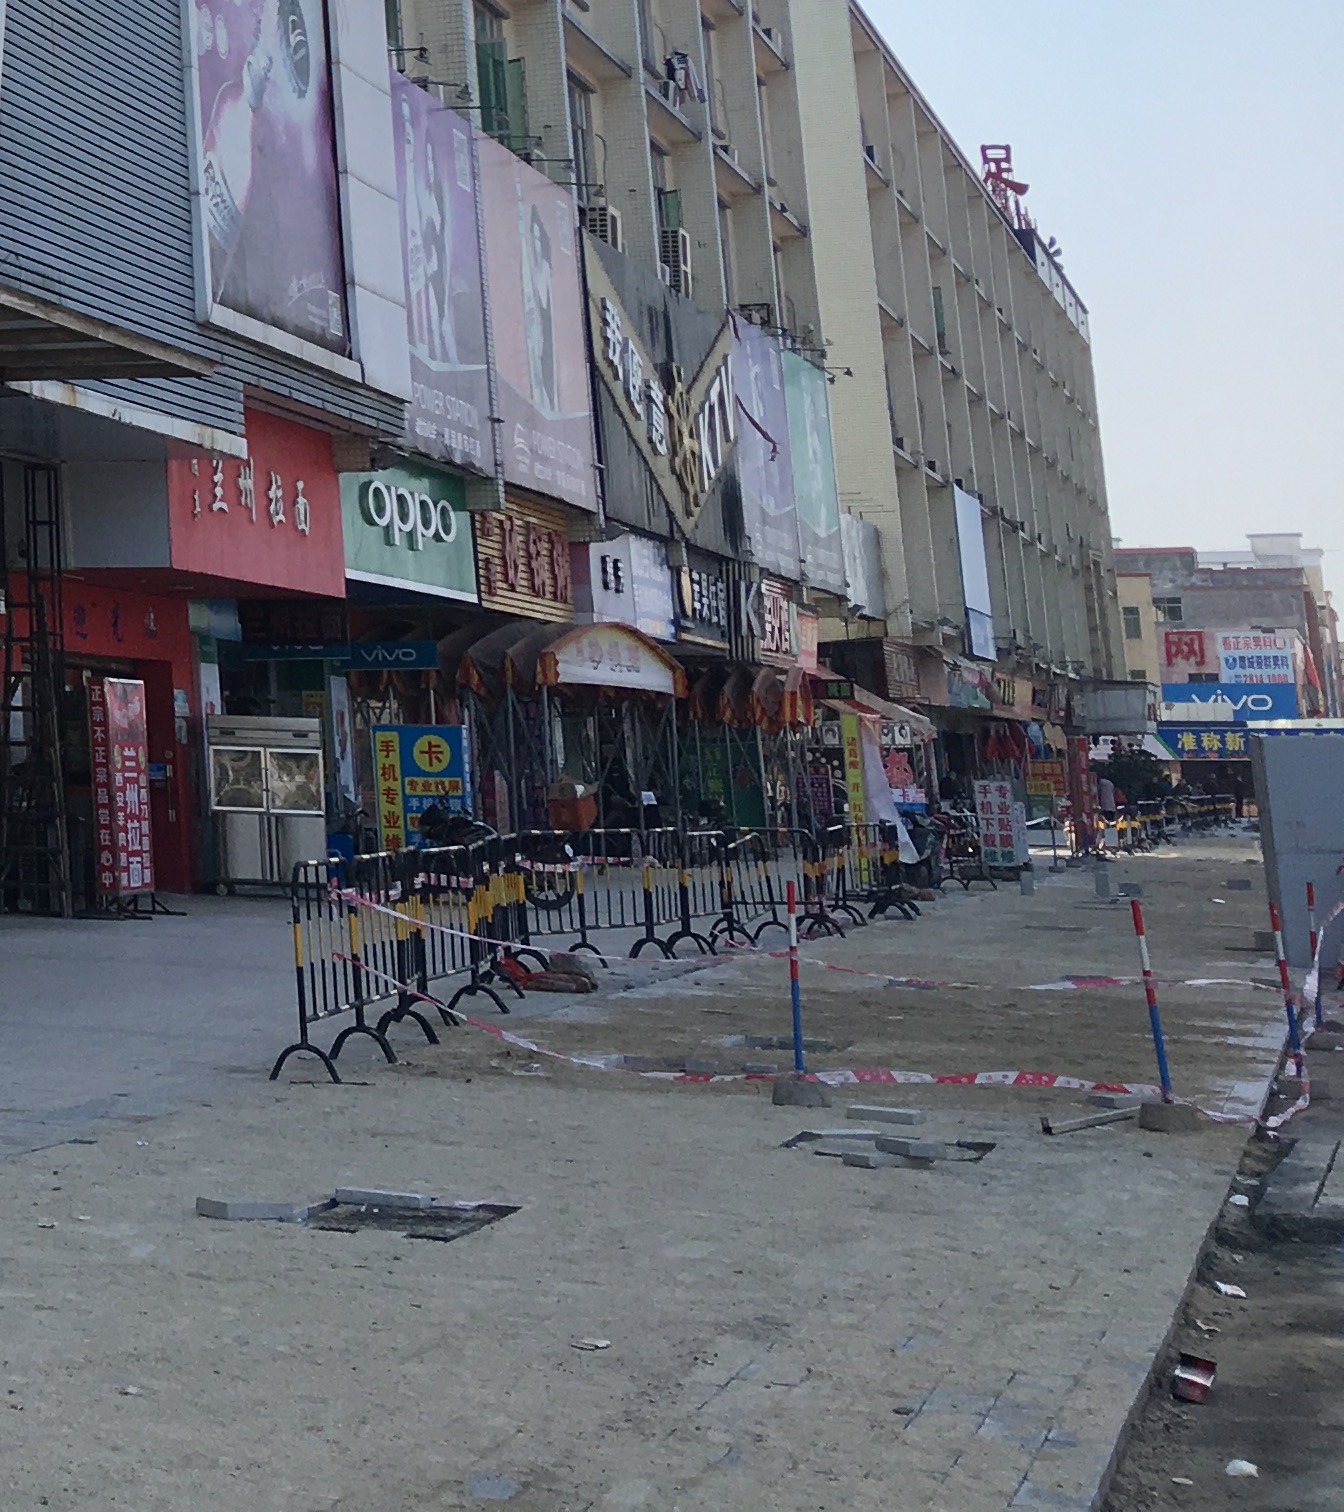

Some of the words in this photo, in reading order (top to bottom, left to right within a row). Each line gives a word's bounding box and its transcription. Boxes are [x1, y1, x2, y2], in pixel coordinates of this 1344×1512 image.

[360, 645, 416, 663] vivo
[1191, 689, 1274, 711] vivo
[419, 741, 444, 767] 卡
[123, 746, 142, 888] 兰州拉面
